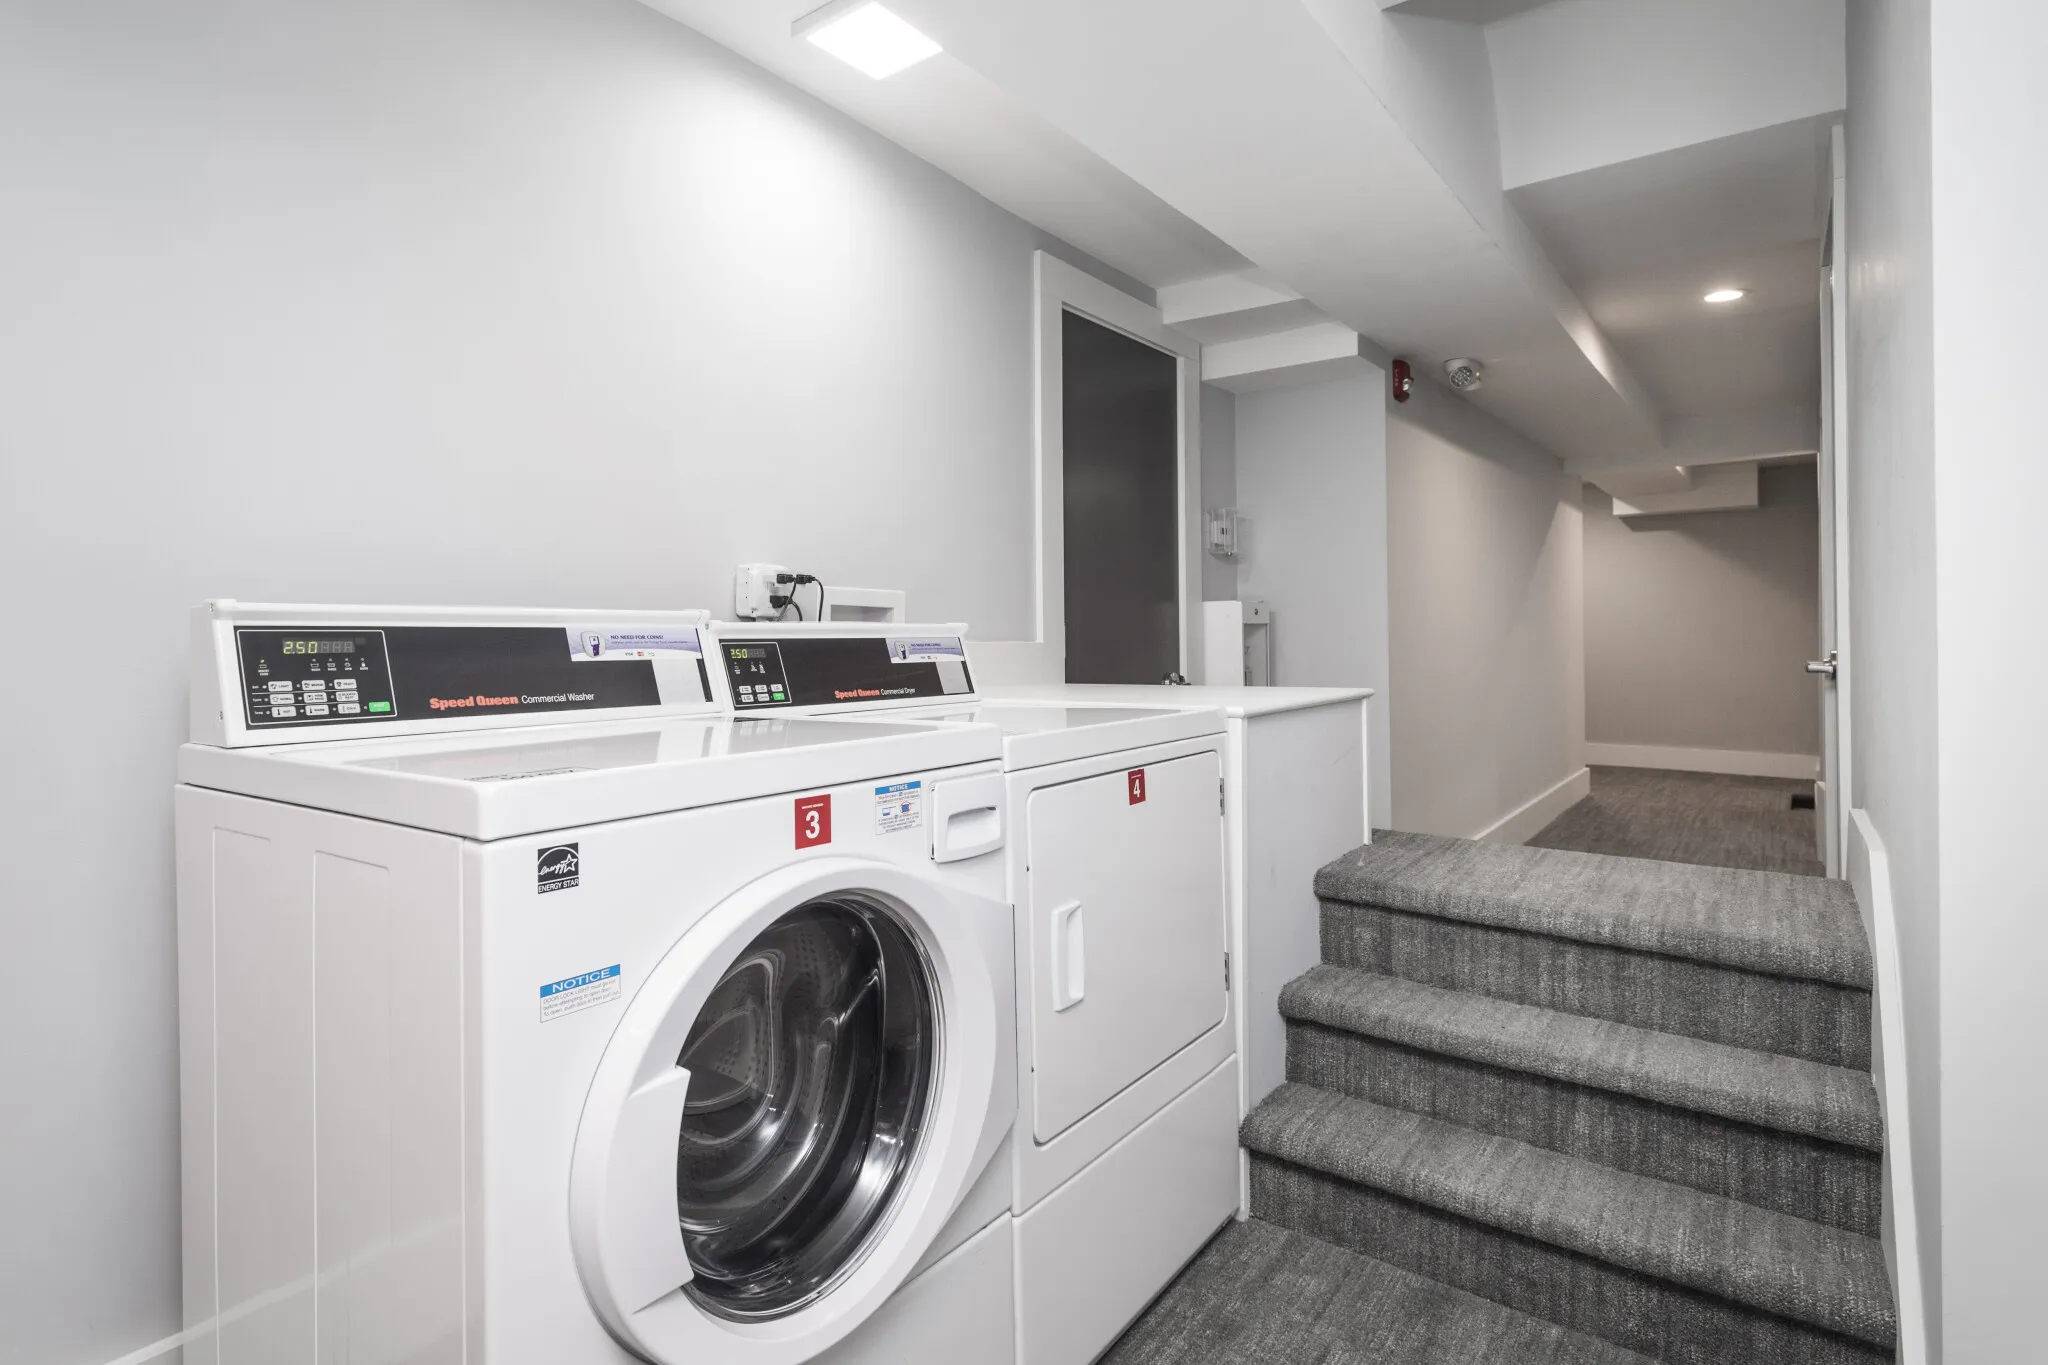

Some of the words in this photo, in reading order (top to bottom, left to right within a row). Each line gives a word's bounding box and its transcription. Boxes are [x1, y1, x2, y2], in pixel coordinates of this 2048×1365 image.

[429, 695, 474, 710] Speed
[476, 694, 519, 706] Queen
[521, 693, 567, 704] Commercial
[567, 692, 595, 701] Washer
[834, 689, 857, 700] Speed
[858, 688, 880, 697] Queen
[889, 783, 909, 792] NOTICE
[1133, 778, 1141, 798] 4
[805, 810, 820, 839] 3
[538, 881, 562, 893] ENERGY
[562, 878, 579, 888] STAR
[552, 968, 611, 993] NOTICE
